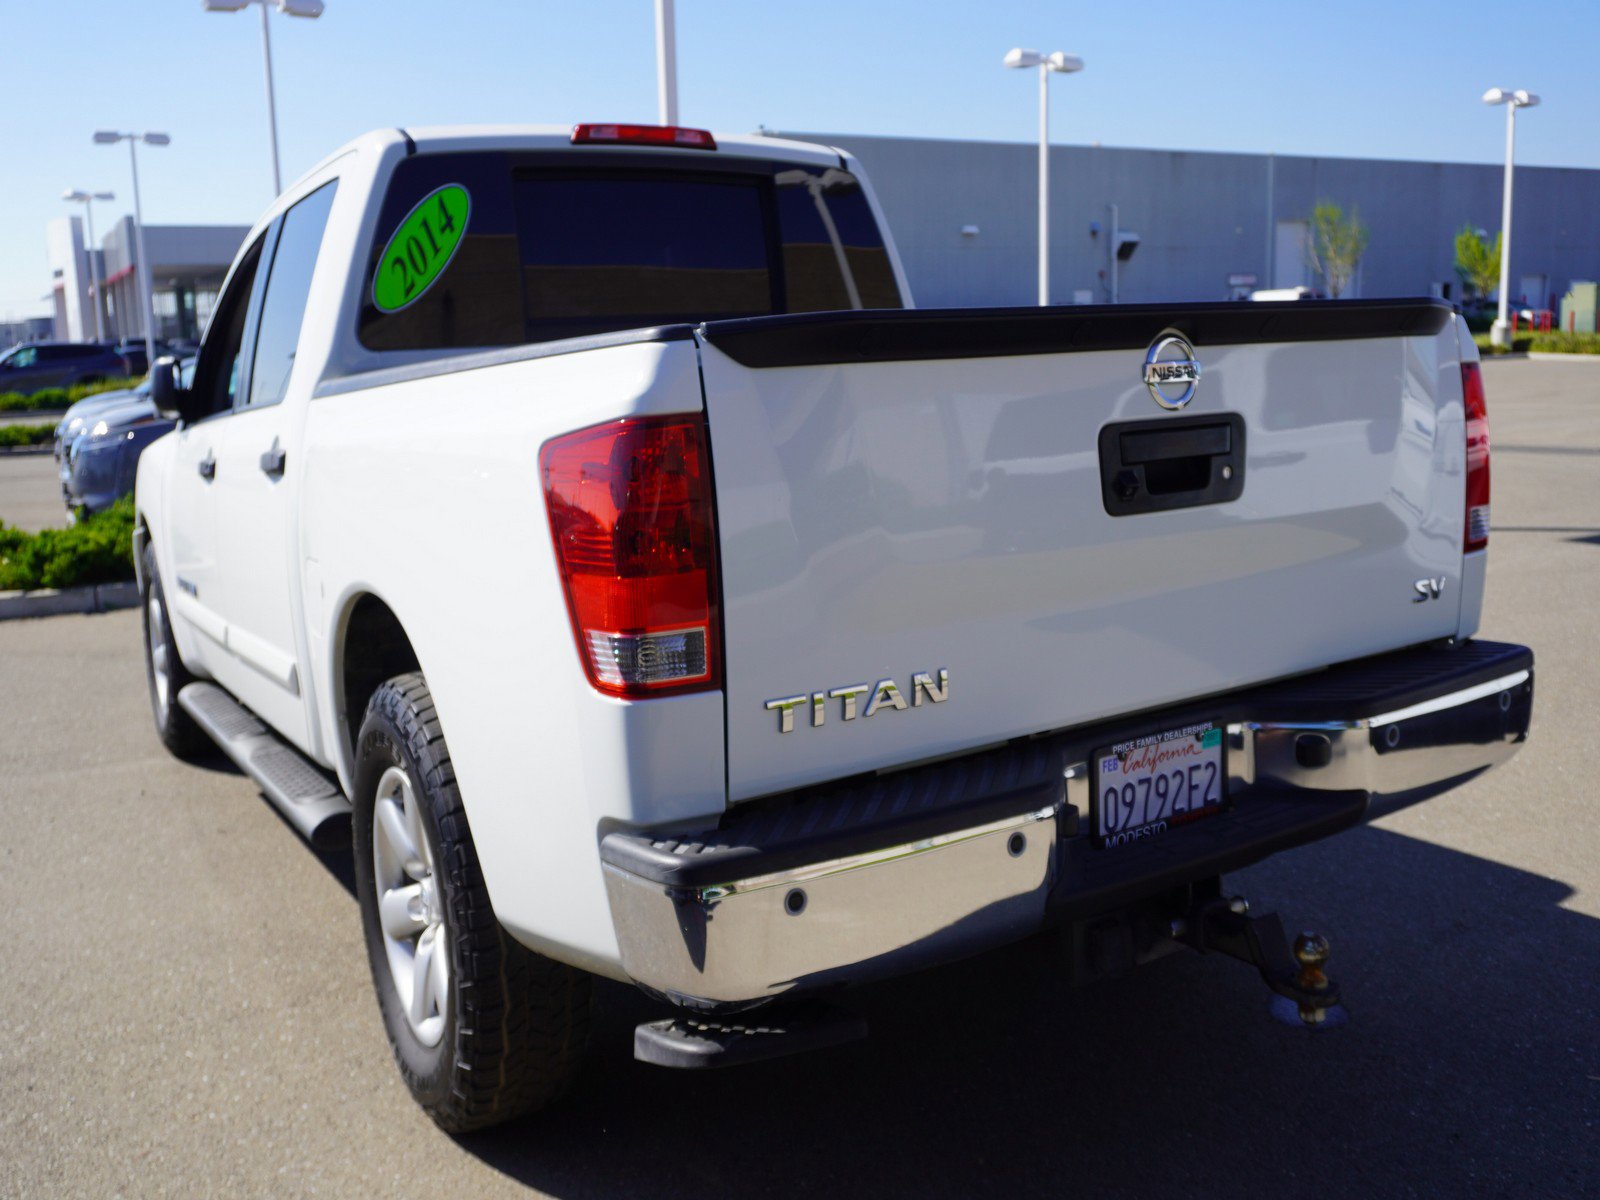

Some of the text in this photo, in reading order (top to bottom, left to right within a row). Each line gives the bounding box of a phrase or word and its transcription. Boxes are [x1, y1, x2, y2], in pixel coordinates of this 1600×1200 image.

[391, 195, 455, 299] 2014
[1151, 365, 1198, 380] NISSAN
[1411, 576, 1446, 603] SV
[764, 667, 948, 733] TITAN
[1112, 740, 1136, 755] PRICE
[1136, 734, 1163, 749] FAMILY
[1164, 722, 1213, 742] DEALERSHIPS
[1103, 758, 1118, 773] FEB
[1122, 742, 1202, 775] California
[1105, 821, 1168, 849] MODESTO
